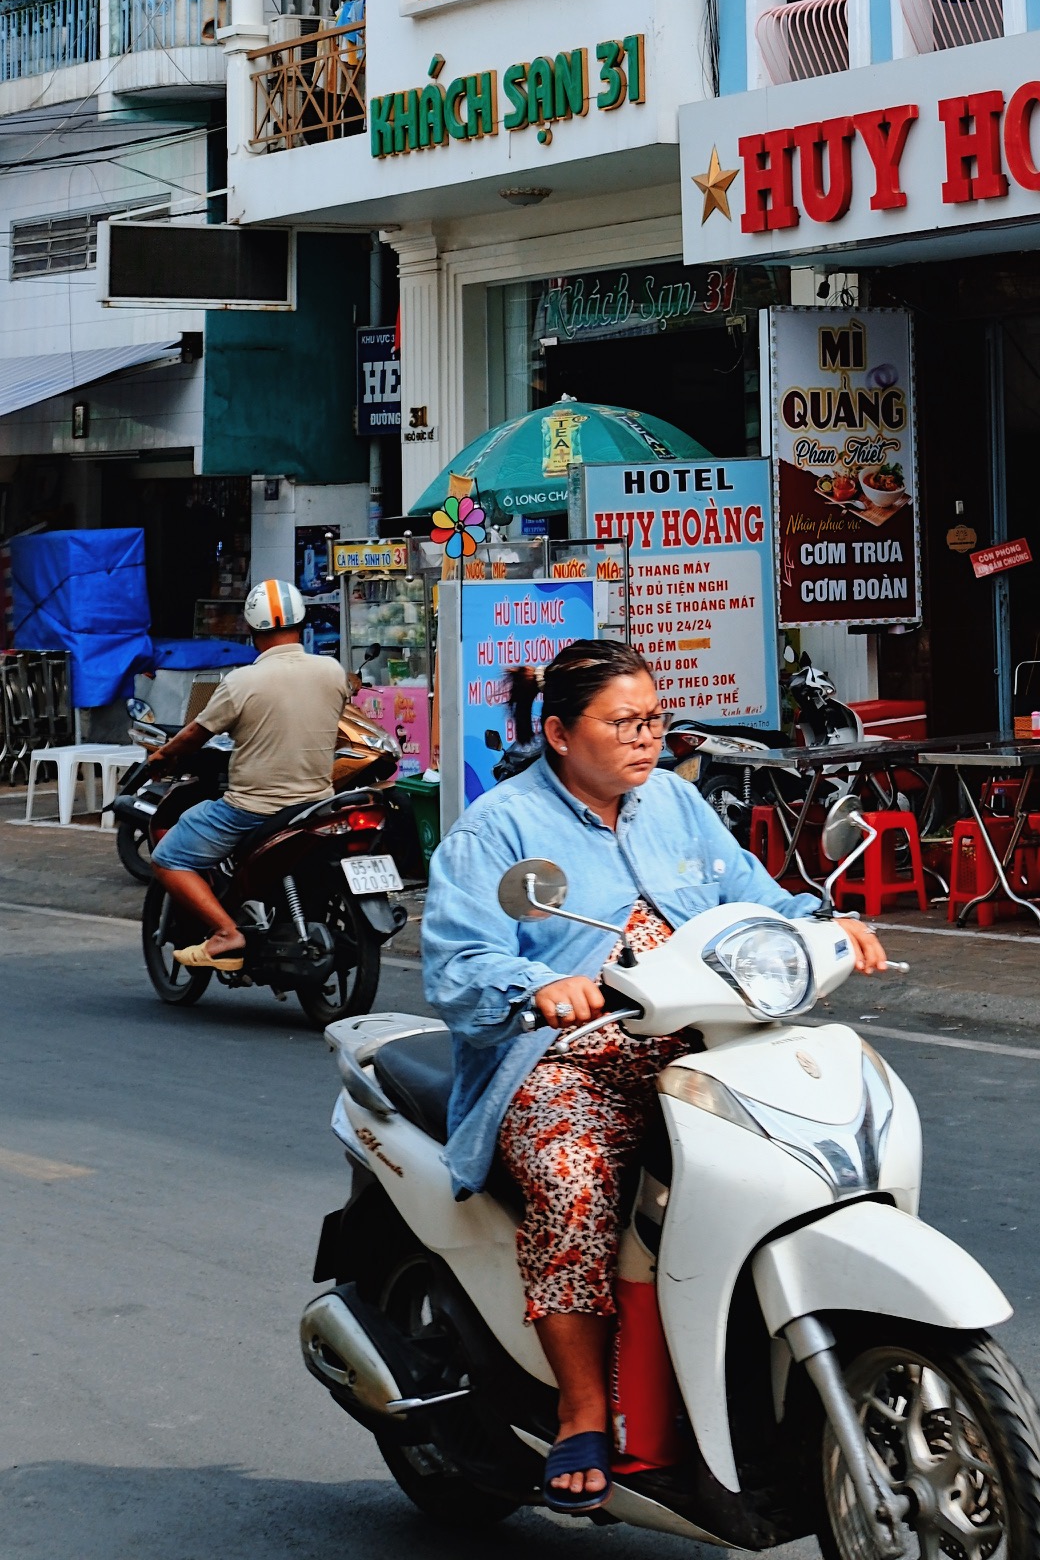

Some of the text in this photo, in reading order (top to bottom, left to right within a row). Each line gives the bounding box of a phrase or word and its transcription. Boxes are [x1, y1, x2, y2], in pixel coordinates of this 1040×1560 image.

[370, 33, 646, 159] KHÁCH SẠN 31
[738, 104, 919, 234] HUY
[545, 268, 738, 339] Khách Sạn 31
[361, 335, 375, 344] KHU
[376, 334, 390, 345] VỰC
[820, 321, 865, 368] MÌ
[782, 376, 905, 430] QUẢNG
[409, 406, 429, 428] 31
[795, 437, 900, 467] Phan Thiết
[624, 467, 734, 494] HOTEL
[503, 495, 513, 507] Ô
[515, 493, 547, 506] LONG
[594, 497, 765, 550] HUY HOÀNG
[785, 512, 815, 535] Nhận
[816, 513, 845, 539] phục
[347, 553, 359, 566] PHÊ
[364, 553, 380, 566] SINH
[382, 550, 391, 565] TỐ
[800, 539, 903, 565] CƠM TRƯA
[553, 557, 620, 580] NƯỚC MÍA
[638, 563, 680, 577] THANG
[684, 561, 710, 575] MÁY
[646, 580, 663, 596] ĐỦ
[667, 580, 695, 597] TIỆN
[698, 579, 729, 593] NGHI
[800, 573, 908, 602] CƠM ĐOÀN
[494, 593, 565, 628] HỦ TIẾU MỰC
[676, 597, 726, 613] THOÁNG
[729, 595, 756, 610] MÁT
[657, 621, 673, 636] VỤ
[676, 618, 712, 633] 24/24
[478, 635, 494, 666] HỦ
[497, 632, 521, 664] TIẾU
[524, 634, 556, 663] SƯỜN
[648, 638, 677, 653] ĐÊM
[675, 657, 699, 670] 80K
[468, 677, 481, 705] MÌ
[677, 675, 709, 690] THEO
[712, 673, 736, 687] 30K
[689, 692, 713, 709] TẬP
[717, 687, 739, 704] THỂ
